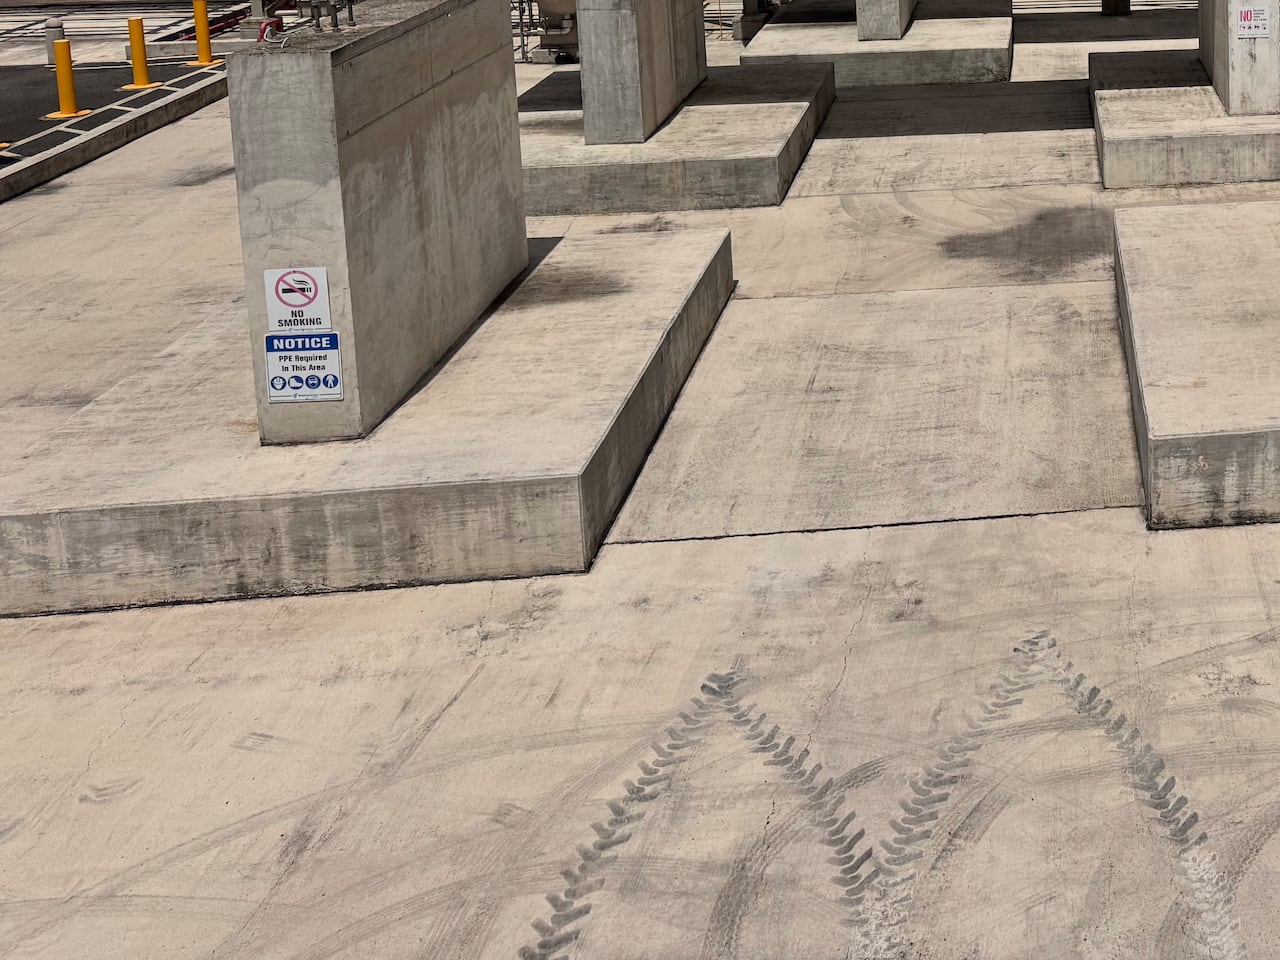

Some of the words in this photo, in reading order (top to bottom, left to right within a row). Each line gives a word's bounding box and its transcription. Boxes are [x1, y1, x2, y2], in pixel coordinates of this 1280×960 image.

[1240, 9, 1252, 22] NO
[291, 310, 304, 318] NO
[278, 318, 322, 327] SMOKING
[273, 337, 330, 349] NOTICE
[278, 355, 293, 363] PPE
[295, 354, 328, 363] Required
[291, 364, 307, 372] This
